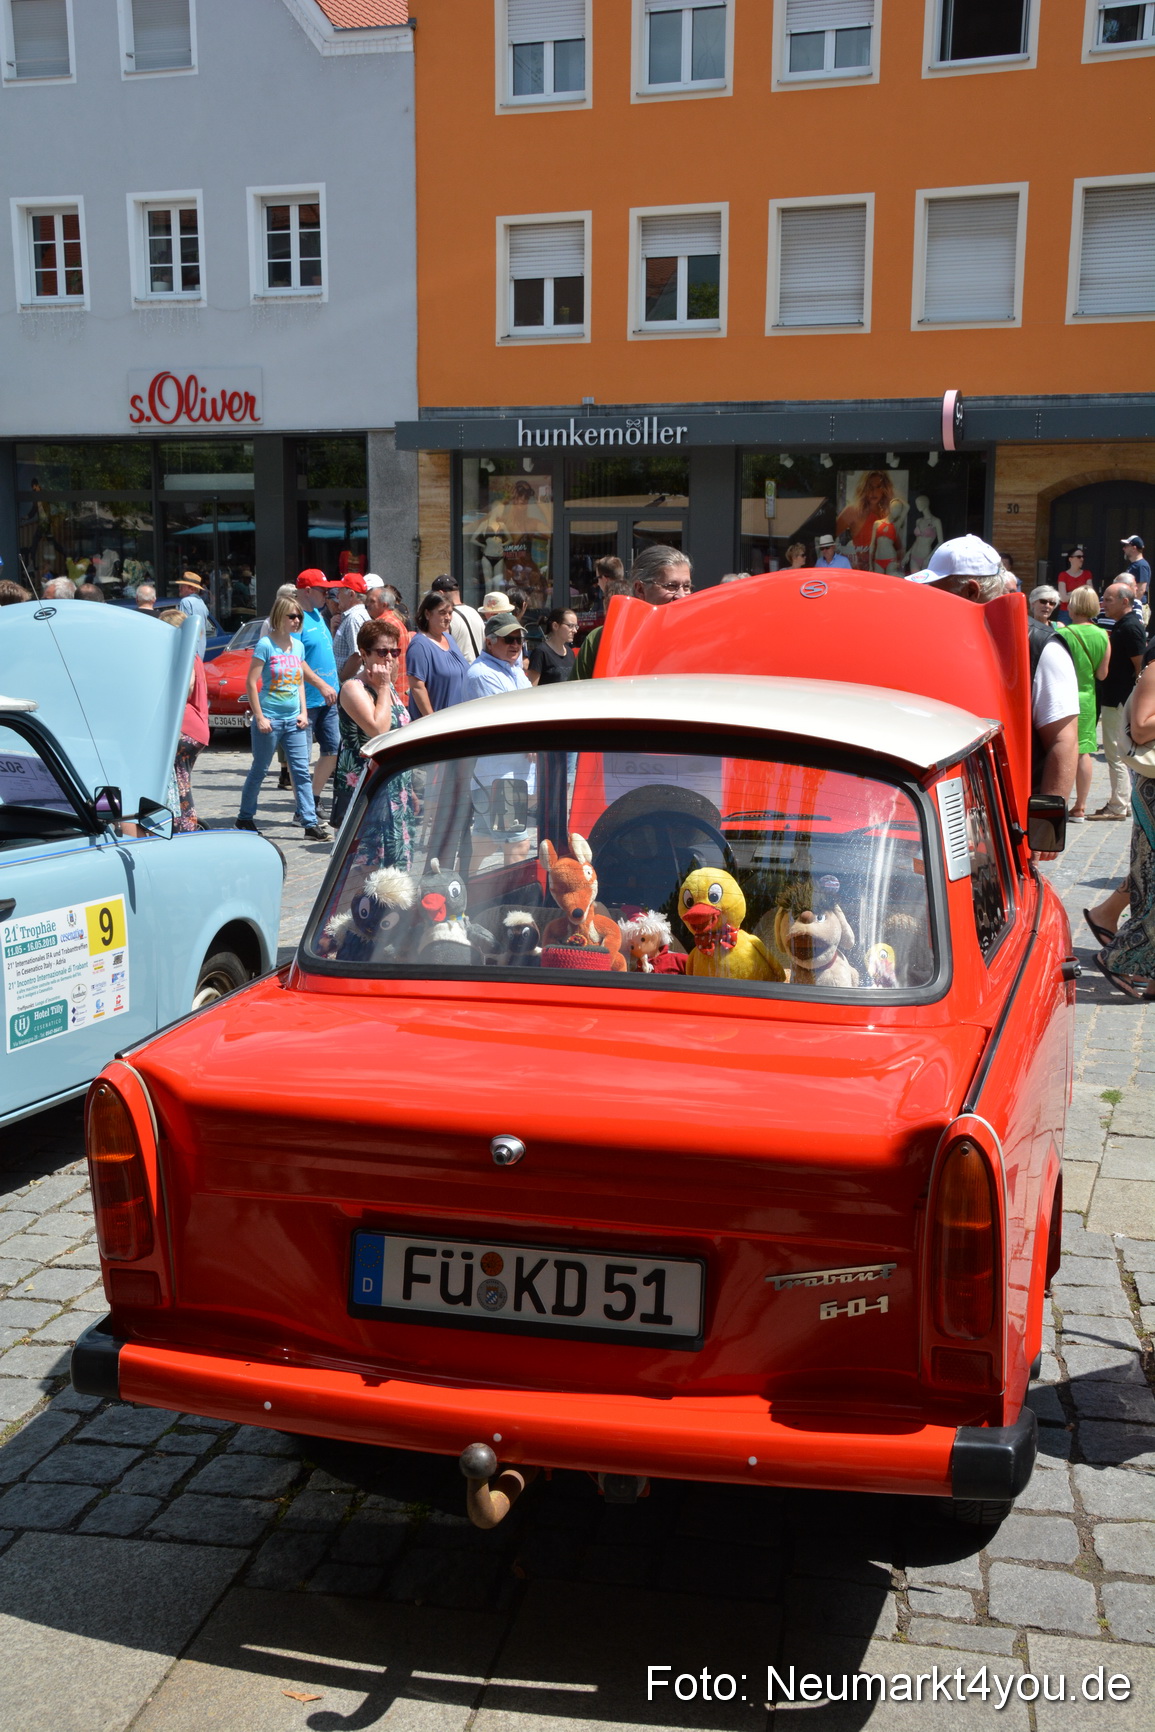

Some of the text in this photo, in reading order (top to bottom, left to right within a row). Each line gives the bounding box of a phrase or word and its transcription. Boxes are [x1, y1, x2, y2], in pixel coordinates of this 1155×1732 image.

[129, 371, 261, 424] s.Oliver
[1006, 503, 1020, 514] 30
[98, 907, 114, 947] 9
[34, 1008, 50, 1020] Hotel
[50, 1004, 64, 1015] Tilly
[362, 1277, 374, 1293] D
[513, 1256, 588, 1317] KD
[603, 1264, 673, 1326] 51
